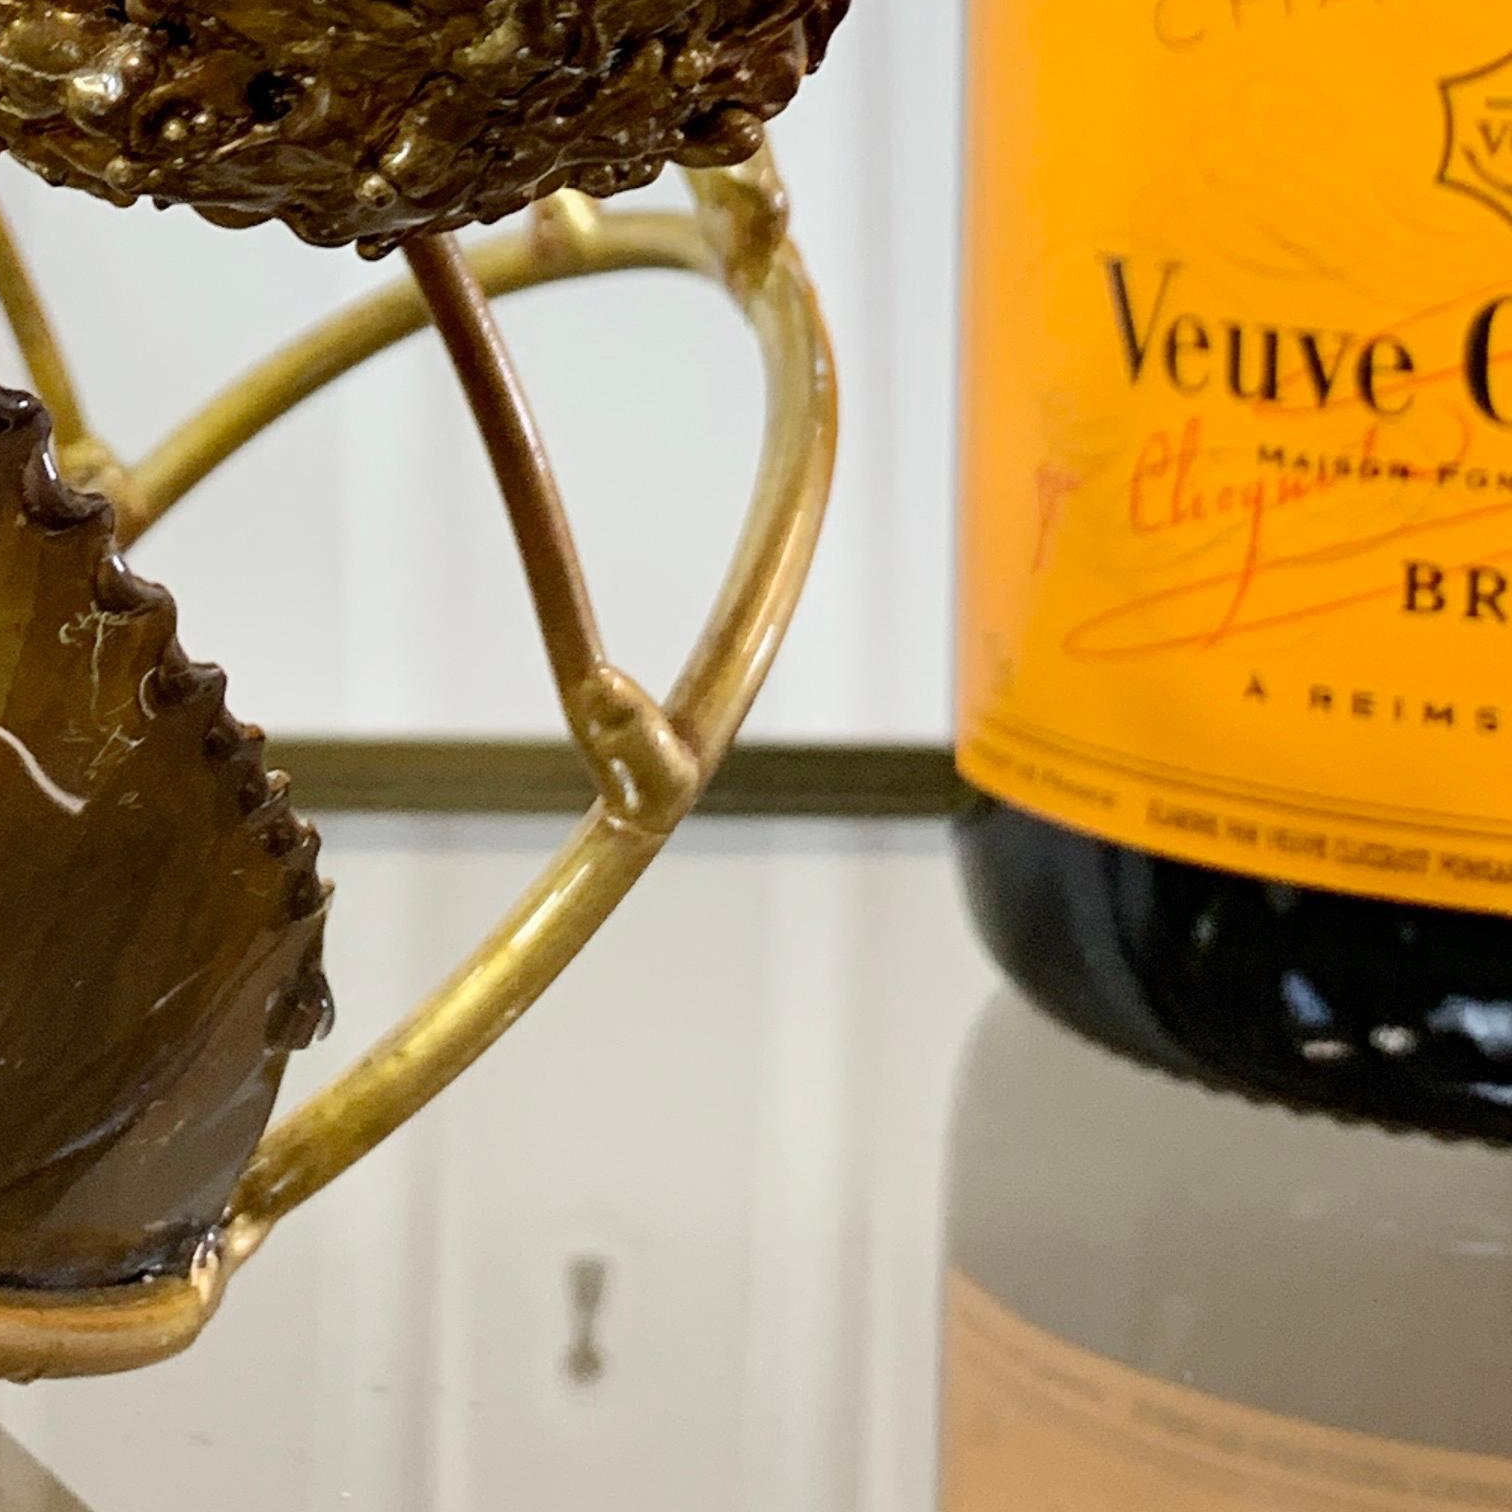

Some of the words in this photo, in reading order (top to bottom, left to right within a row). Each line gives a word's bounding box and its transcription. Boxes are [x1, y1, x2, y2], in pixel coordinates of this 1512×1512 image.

[1095, 252, 1416, 416] Veuve
[1402, 558, 1508, 625] BR
[1307, 683, 1500, 736] REIMS
